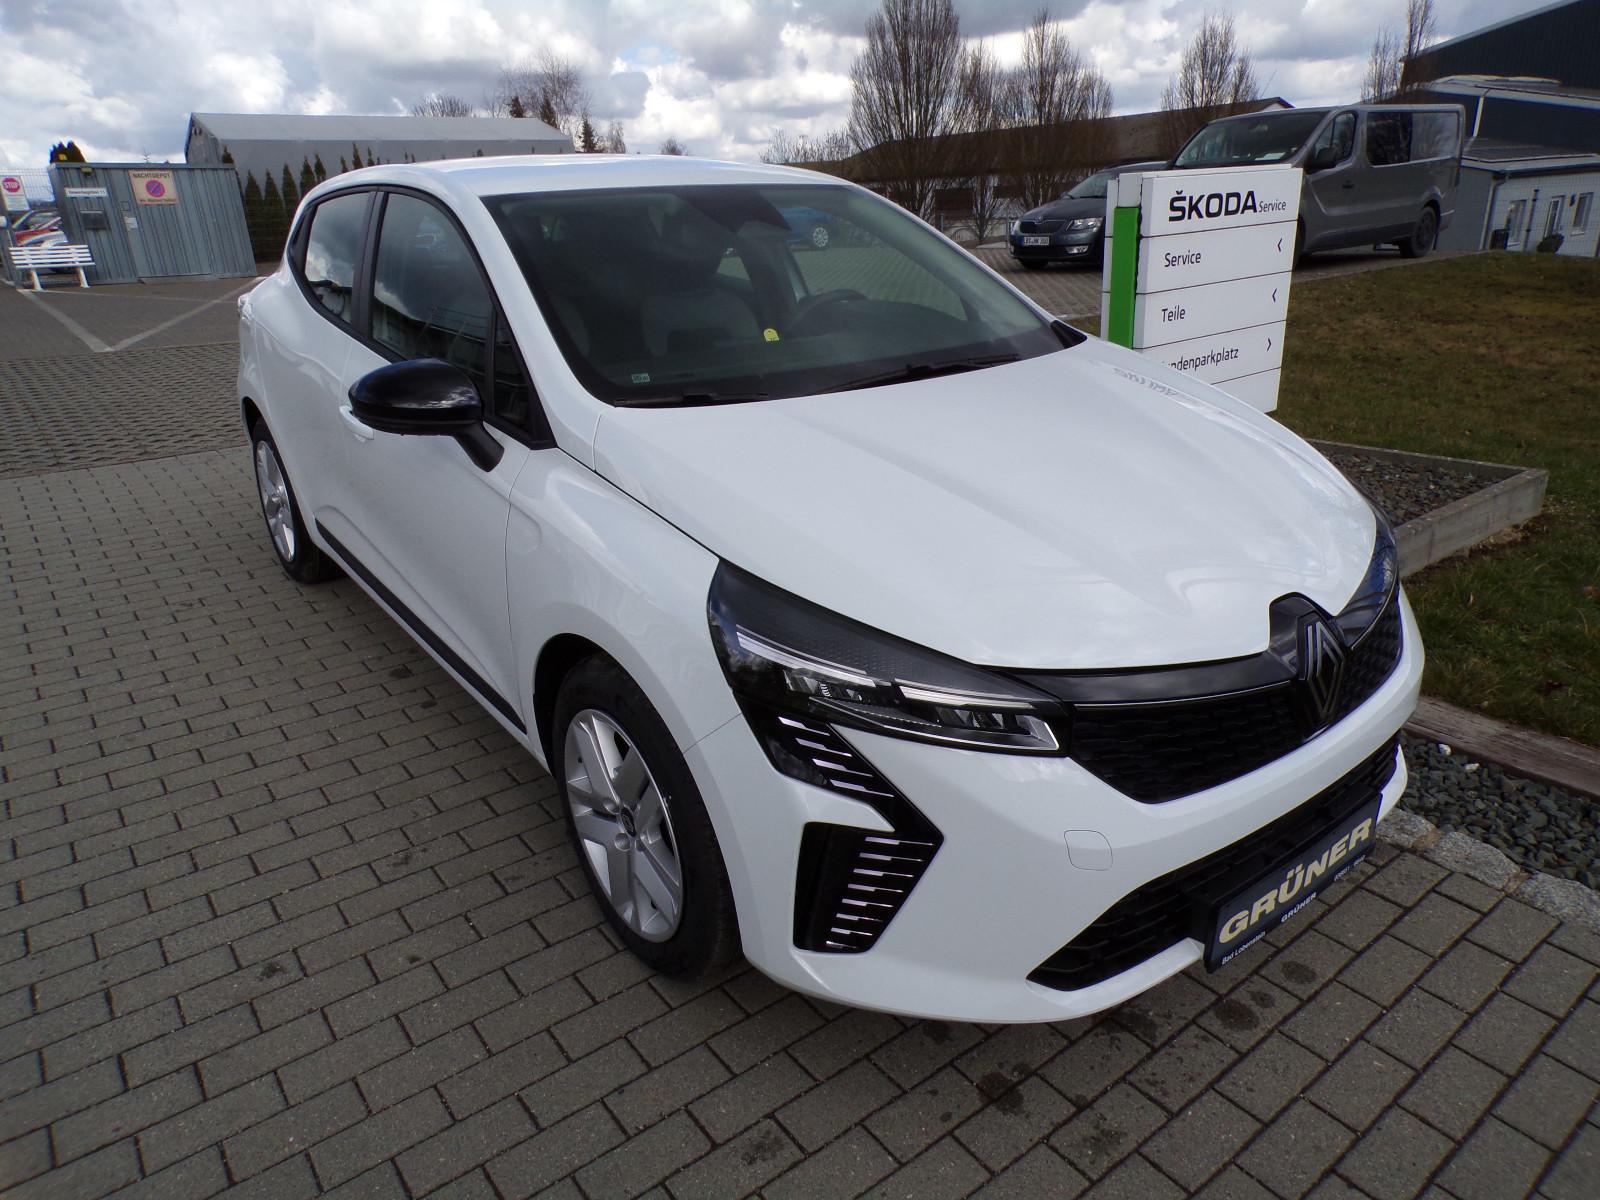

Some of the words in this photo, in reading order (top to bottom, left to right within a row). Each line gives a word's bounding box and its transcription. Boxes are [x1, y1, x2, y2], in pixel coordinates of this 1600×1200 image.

[2, 181, 18, 189] STOP
[1168, 189, 1257, 222] ŠKODA
[1258, 198, 1287, 213] Service
[1164, 249, 1202, 268] Service
[1161, 305, 1186, 323] Teile
[1162, 347, 1239, 371] ndenparkplatz
[1219, 817, 1372, 944] GRÜNER
[1280, 891, 1317, 923] GRÜNER
[1221, 951, 1234, 965] Bad
